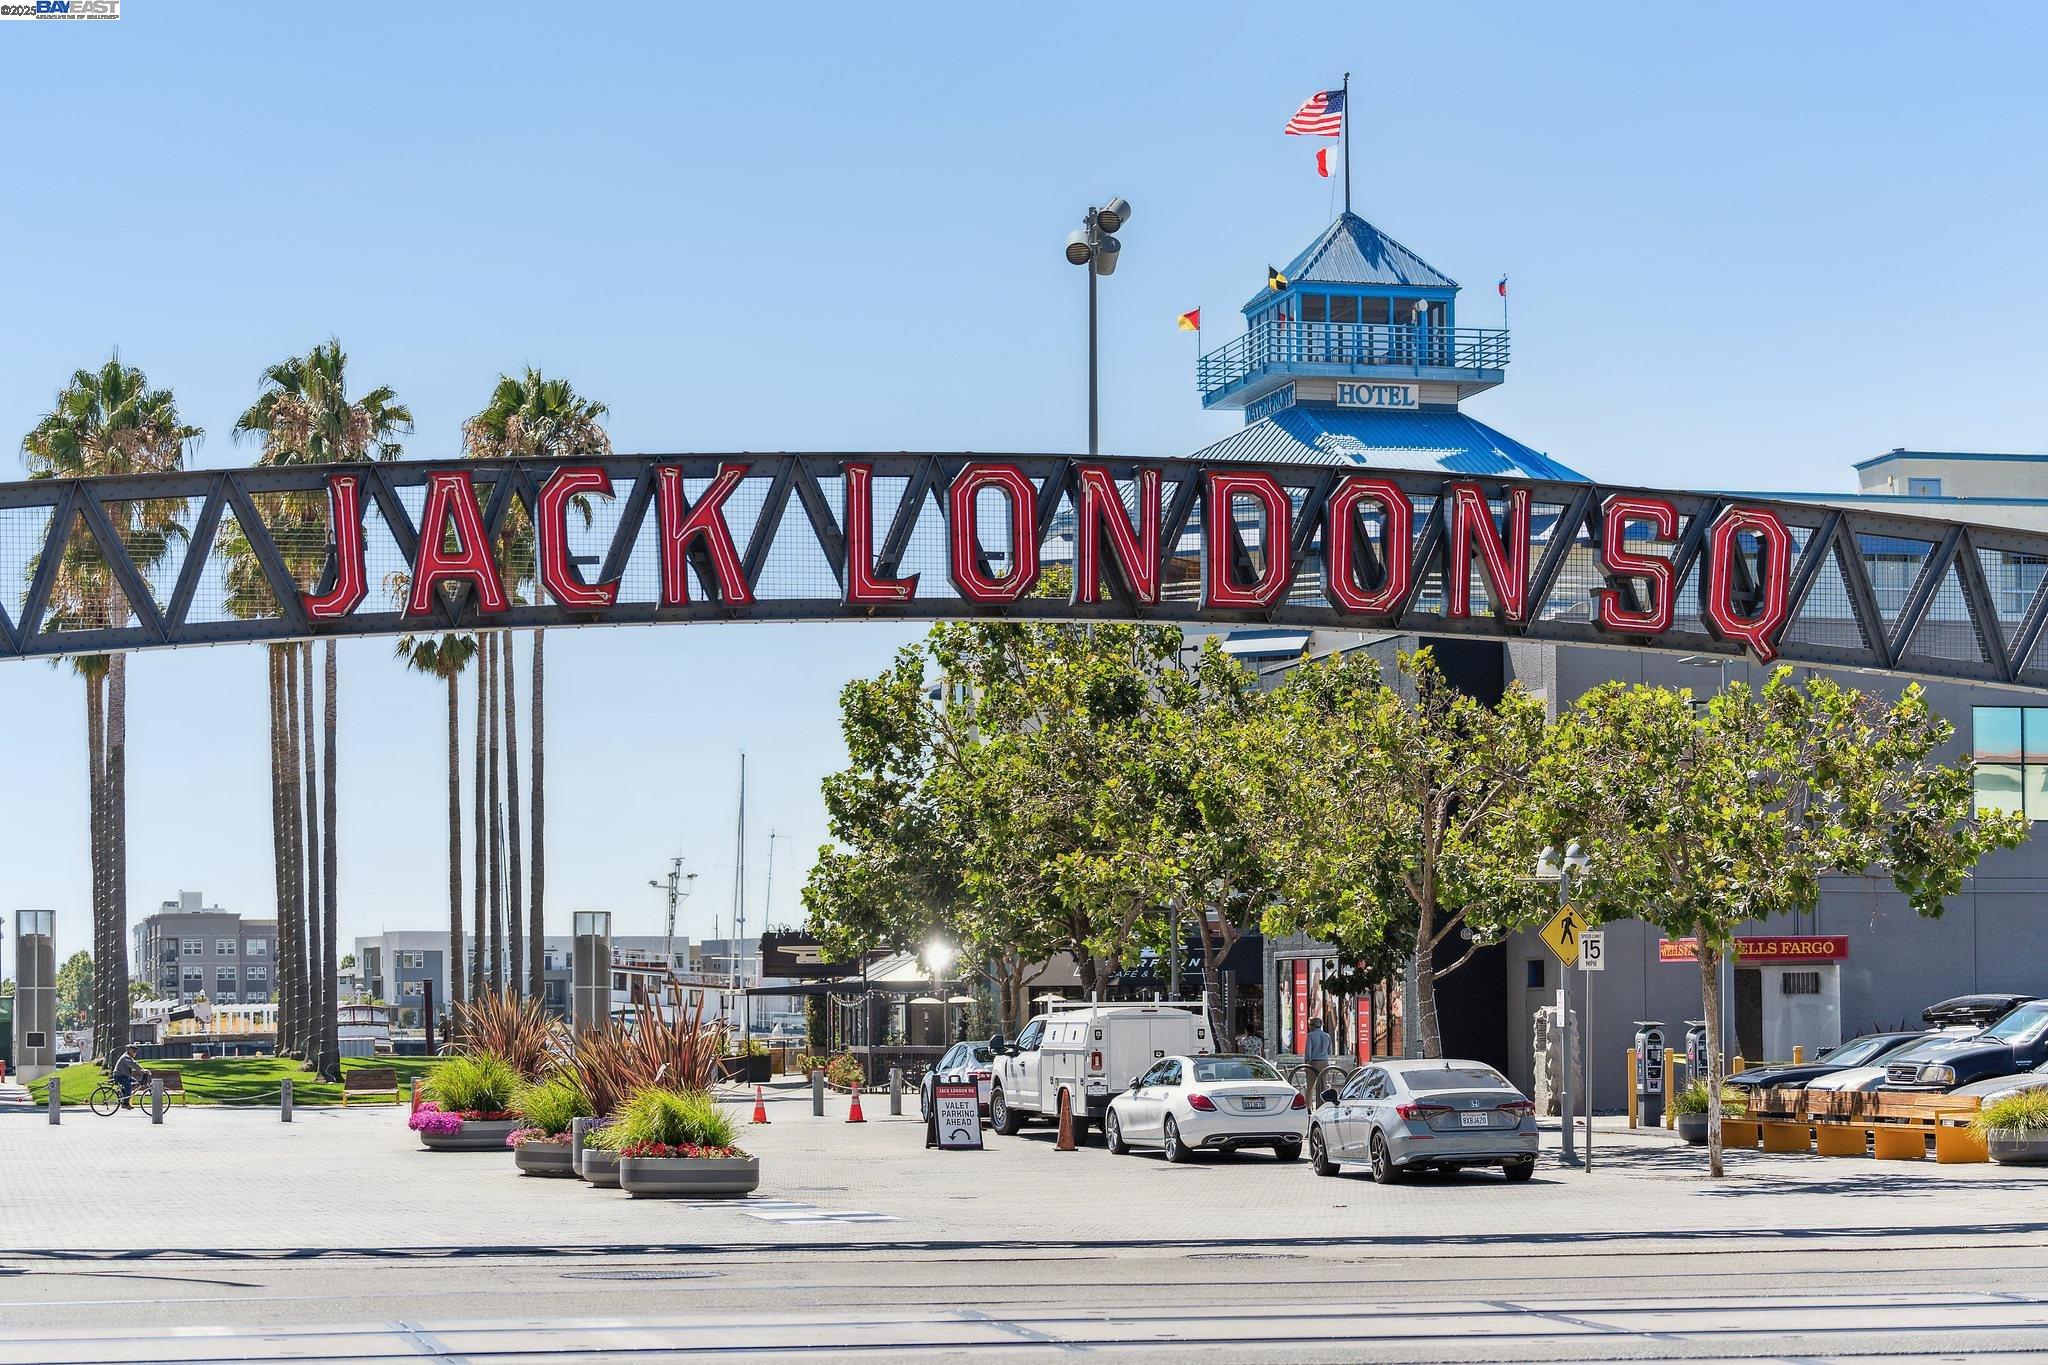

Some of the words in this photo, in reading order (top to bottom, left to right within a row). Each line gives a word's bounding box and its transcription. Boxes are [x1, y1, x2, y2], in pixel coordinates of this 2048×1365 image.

[1338, 383, 1415, 407] HOTEL
[300, 463, 756, 620] JACK
[842, 461, 1533, 626] LONDON
[1590, 493, 1793, 665] SQ
[1582, 939, 1601, 960] 15
[1660, 942, 1684, 957] WELLS
[1780, 941, 1835, 954] FARGO
[1141, 970, 1149, 978] &
[941, 1110, 975, 1118] PARKING
[946, 1118, 972, 1126] AHEAD
